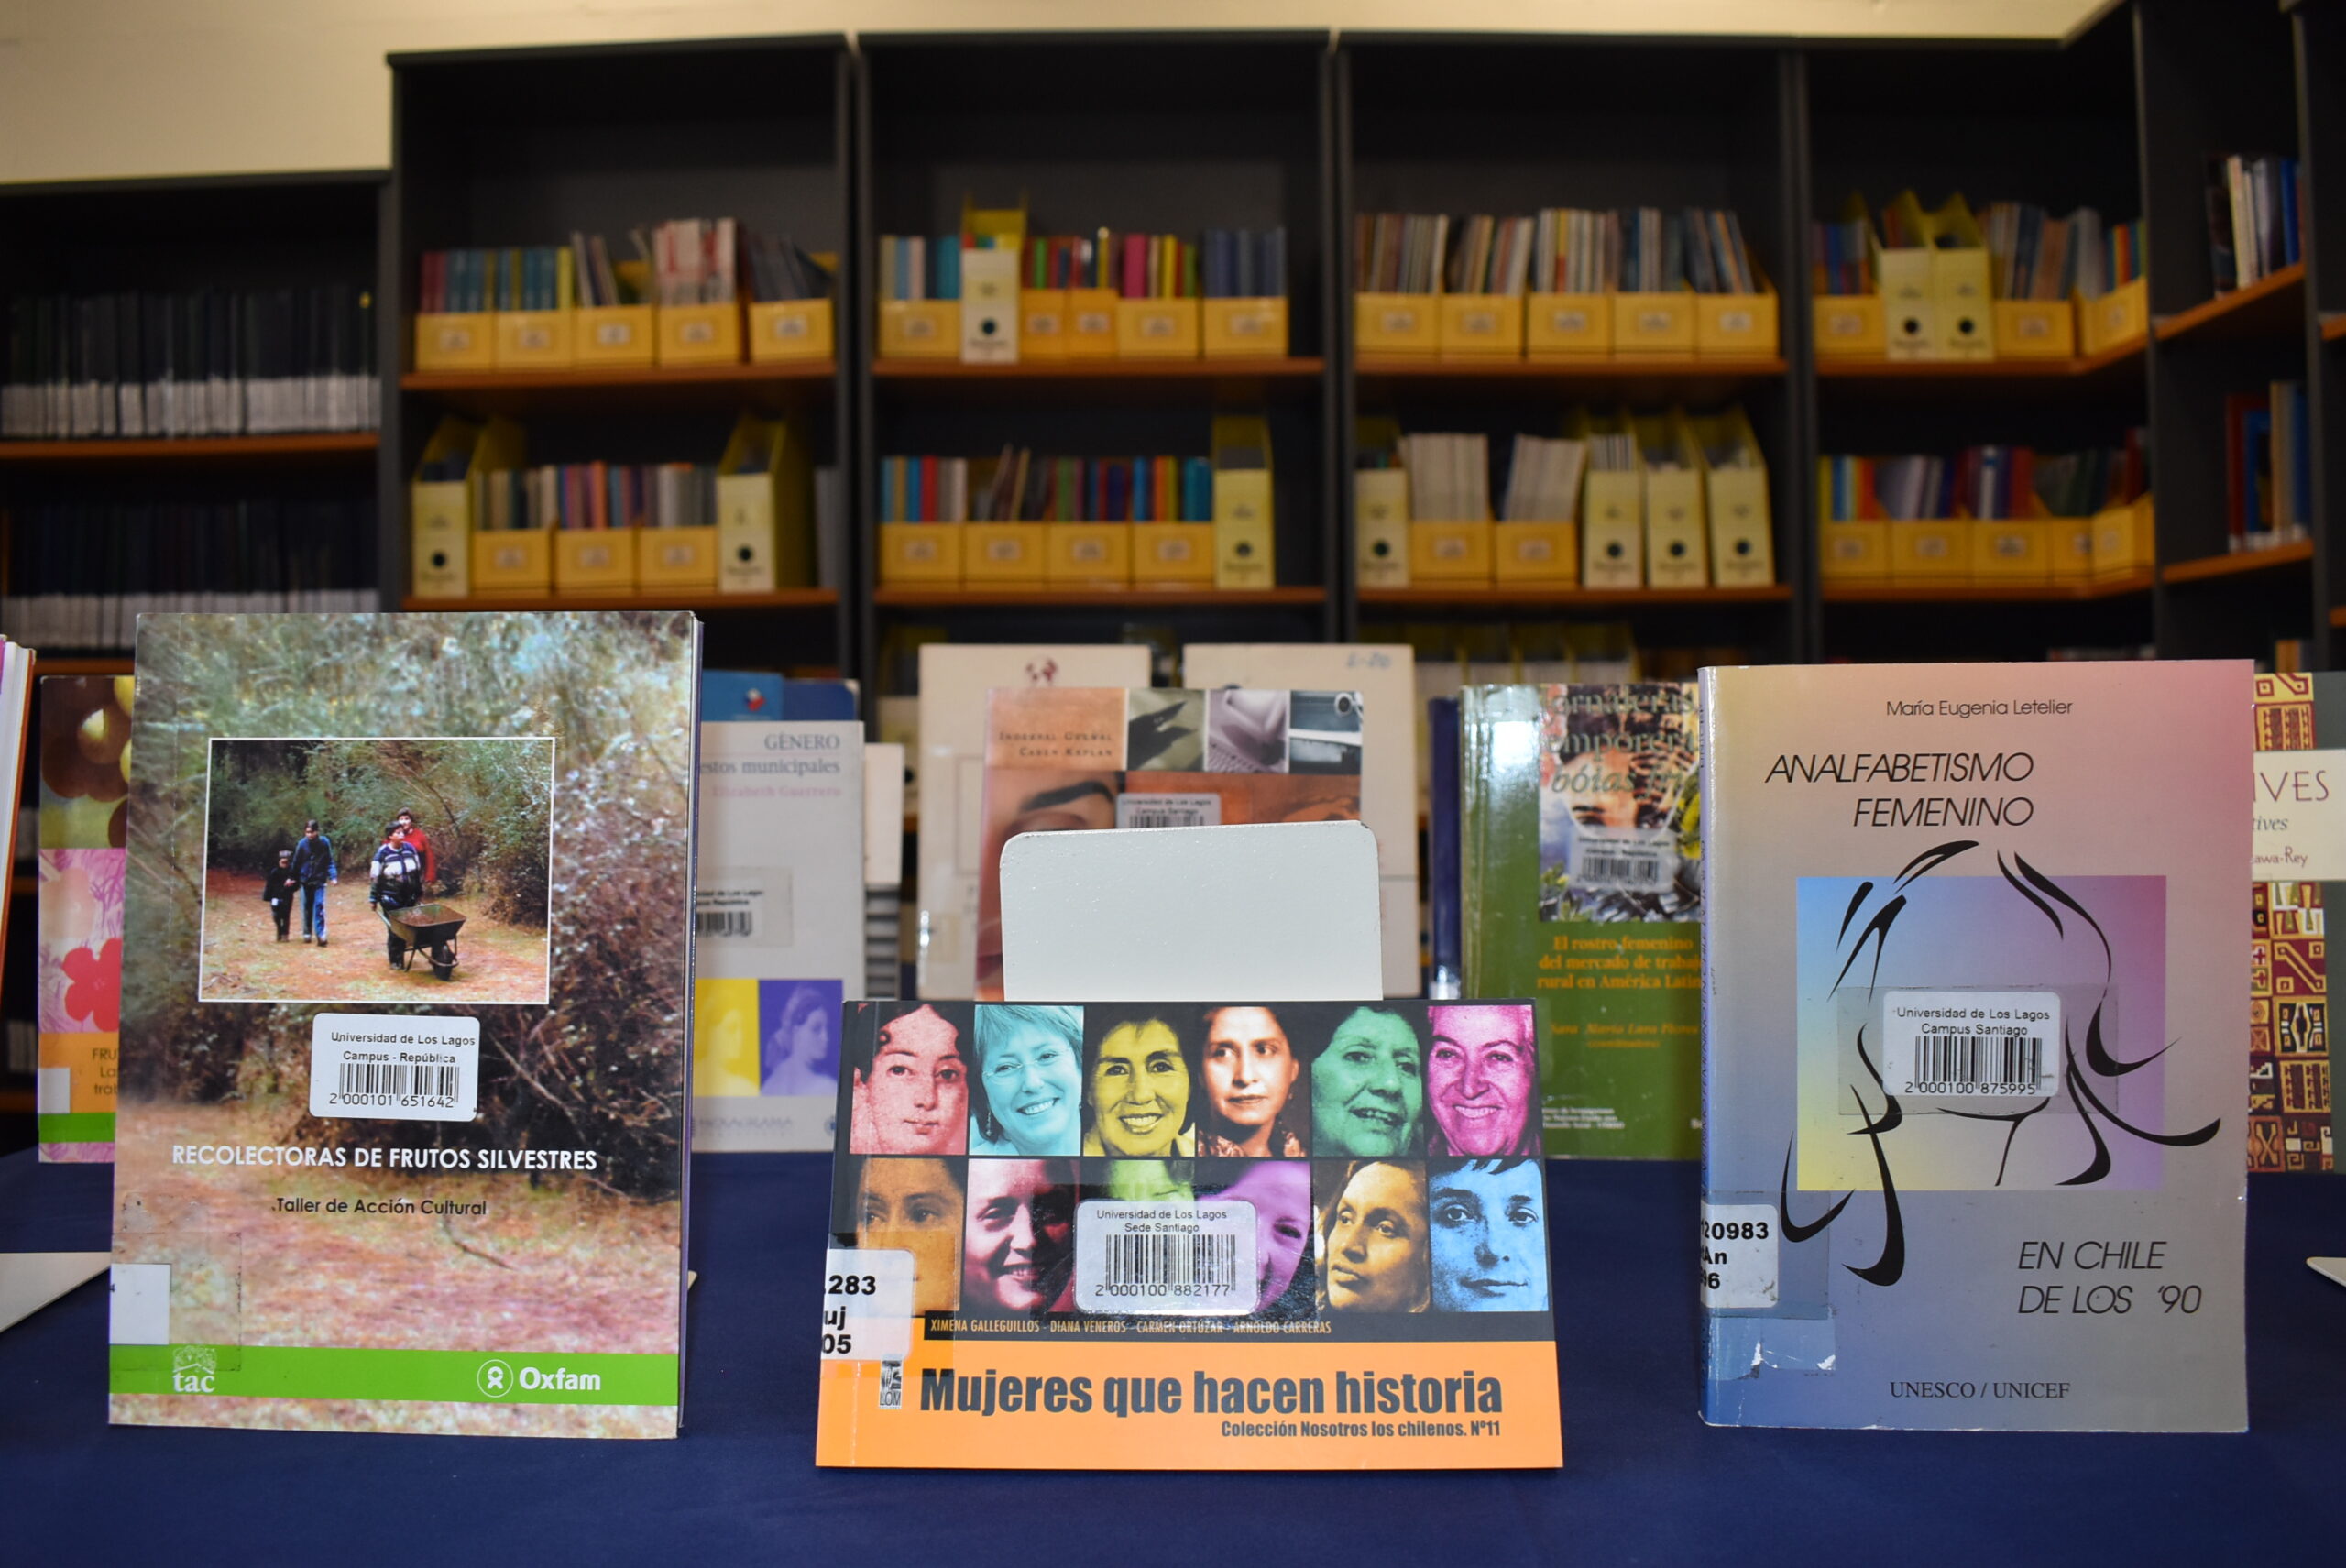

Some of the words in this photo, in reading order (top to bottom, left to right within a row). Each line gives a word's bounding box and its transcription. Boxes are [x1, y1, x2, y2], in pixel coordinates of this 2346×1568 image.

[1886, 700, 1934, 717] María
[1939, 699, 2008, 718] Eugenia
[2013, 699, 2073, 715] Letelier
[741, 757, 840, 777] municipales
[1764, 751, 2034, 784] ANALFABETISMO
[2253, 770, 2329, 802] IVES
[1853, 796, 2034, 827] FEMENINO
[2253, 846, 2308, 868] awa-Rey
[1553, 935, 1568, 950] El
[1572, 938, 1617, 950] rostro
[1620, 935, 1693, 950] femenino
[1538, 954, 1562, 970] del
[1566, 954, 1629, 970] mercado
[1634, 954, 1651, 970] de
[1655, 954, 1702, 972] trabaj
[1538, 973, 1574, 989] rural
[1578, 977, 1595, 989] en
[1600, 973, 1661, 989] América
[1665, 974, 1702, 989] Latin
[1897, 1006, 1967, 1019] Universidad
[1970, 1008, 1985, 1019] de
[1990, 1009, 2010, 1019] Los
[2014, 1009, 2050, 1022] Lagos
[1921, 1023, 1971, 1036] Campus
[1976, 1025, 2028, 1037] Santiago
[331, 1032, 397, 1044] Universidad
[400, 1034, 414, 1044] de
[418, 1035, 437, 1045] Los
[442, 1036, 475, 1047] Lagos
[92, 1047, 117, 1060] FRU
[343, 1050, 389, 1063] Campus
[400, 1052, 455, 1064] República
[1904, 1081, 1913, 1093] 2
[1919, 1081, 1974, 1093] 000100
[1980, 1082, 2035, 1095] 875995
[329, 1092, 338, 1104] 2
[343, 1093, 393, 1106] 000101
[400, 1095, 454, 1108] 651642
[172, 1145, 346, 1167] RECOLECTORAS
[354, 1147, 382, 1168] DE
[389, 1147, 471, 1169] FRUTOS
[477, 1149, 597, 1170] SILVESTRES
[277, 1197, 320, 1213] Taller
[325, 1197, 348, 1213] de
[354, 1197, 415, 1214] Acción
[421, 1199, 487, 1216] Cultural
[1096, 1210, 1157, 1220] Universidad
[1159, 1210, 1171, 1220] de
[1174, 1210, 1193, 1220] Los
[1196, 1210, 1227, 1222] Lagos
[1124, 1223, 1151, 1233] Sede
[1154, 1223, 1200, 1234] Santiago
[1701, 1218, 1769, 1240] 20983
[1702, 1246, 1727, 1265] An
[2017, 1241, 2064, 1269] EN
[2074, 1241, 2167, 1269] CHILE
[1095, 1284, 1104, 1297] 2
[1111, 1284, 1167, 1297] 000100
[1173, 1284, 1230, 1297] 882177
[2017, 1285, 2063, 1314] DE
[2072, 1285, 2132, 1315] LOS
[2158, 1285, 2202, 1314] '90
[823, 1306, 846, 1331] uj
[930, 1319, 967, 1332] XIMENA
[970, 1320, 1039, 1333] GALLEGUILLOS
[1050, 1320, 1080, 1333] DIANA
[1083, 1321, 1126, 1333] VENEROS
[1136, 1321, 1176, 1333] CARMEN
[1283, 1321, 1332, 1334] CARRERAS
[821, 1333, 852, 1354] 05
[172, 1371, 215, 1394] tac
[519, 1366, 601, 1391] Oxfam
[920, 1369, 1092, 1417] Mujeres
[1103, 1379, 1182, 1418] que
[1194, 1370, 1325, 1414] hacen
[1336, 1370, 1503, 1414] historia
[1890, 1381, 1976, 1399] UNESCO
[1980, 1382, 1988, 1398] /
[1993, 1382, 2070, 1399] UNICEF
[1221, 1420, 1297, 1437] Colección
[1301, 1421, 1367, 1437] Nosotros
[1372, 1421, 1394, 1437] los
[1398, 1421, 1467, 1437] chilenos.
